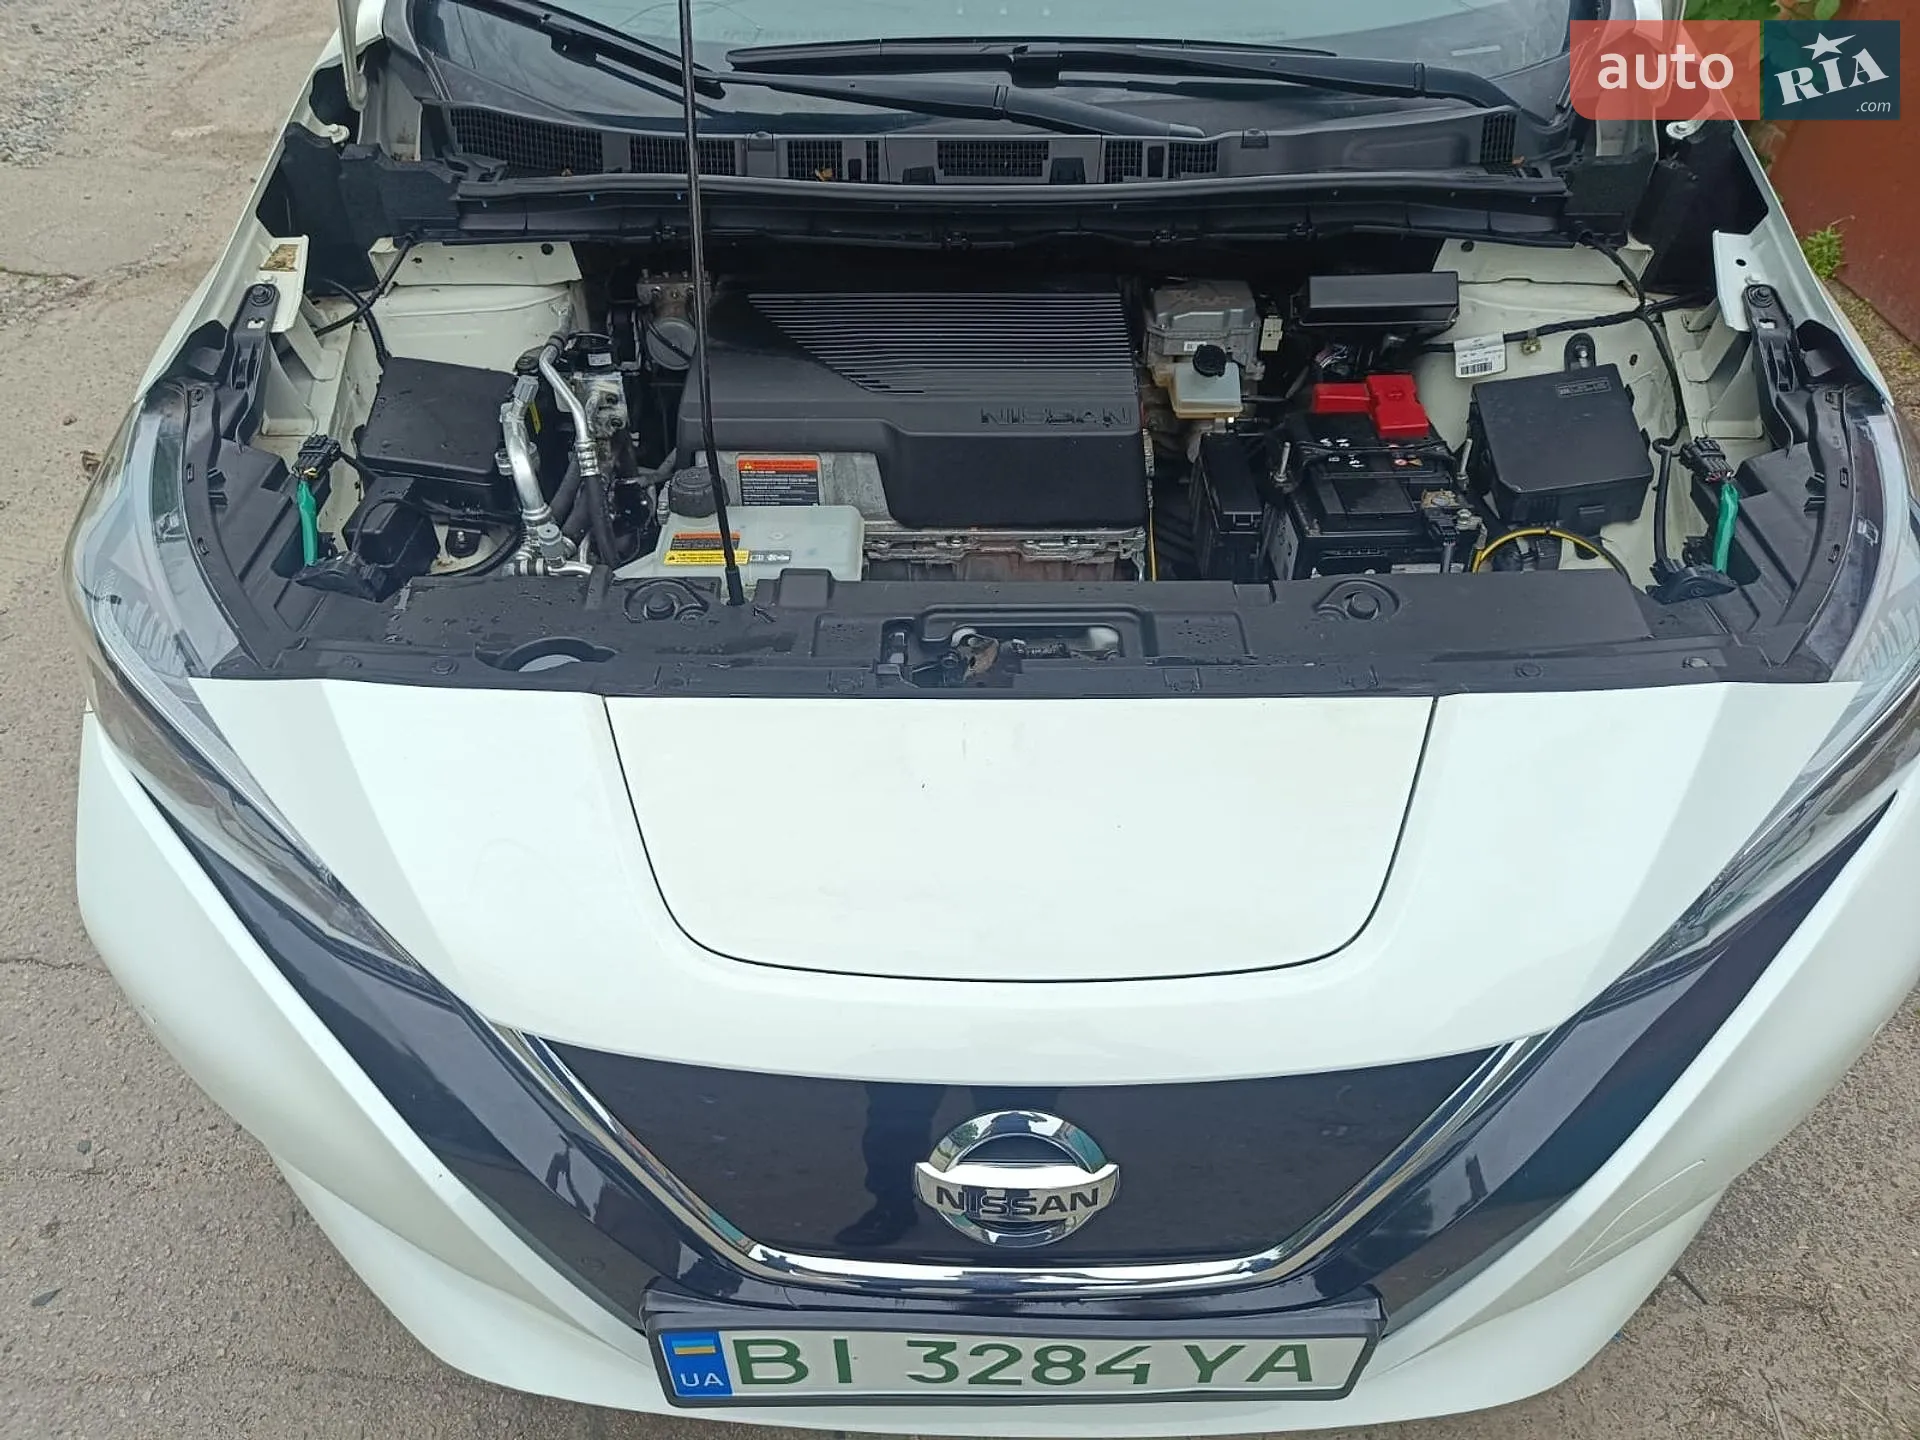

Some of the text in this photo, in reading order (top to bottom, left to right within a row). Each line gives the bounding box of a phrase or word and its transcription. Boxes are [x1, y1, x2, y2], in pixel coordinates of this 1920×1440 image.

[980, 407, 1132, 425] NISSAN
[936, 1186, 1099, 1216] NISSAN
[732, 1338, 1313, 1386] BI 3284 YA
[680, 1372, 725, 1387] UA
